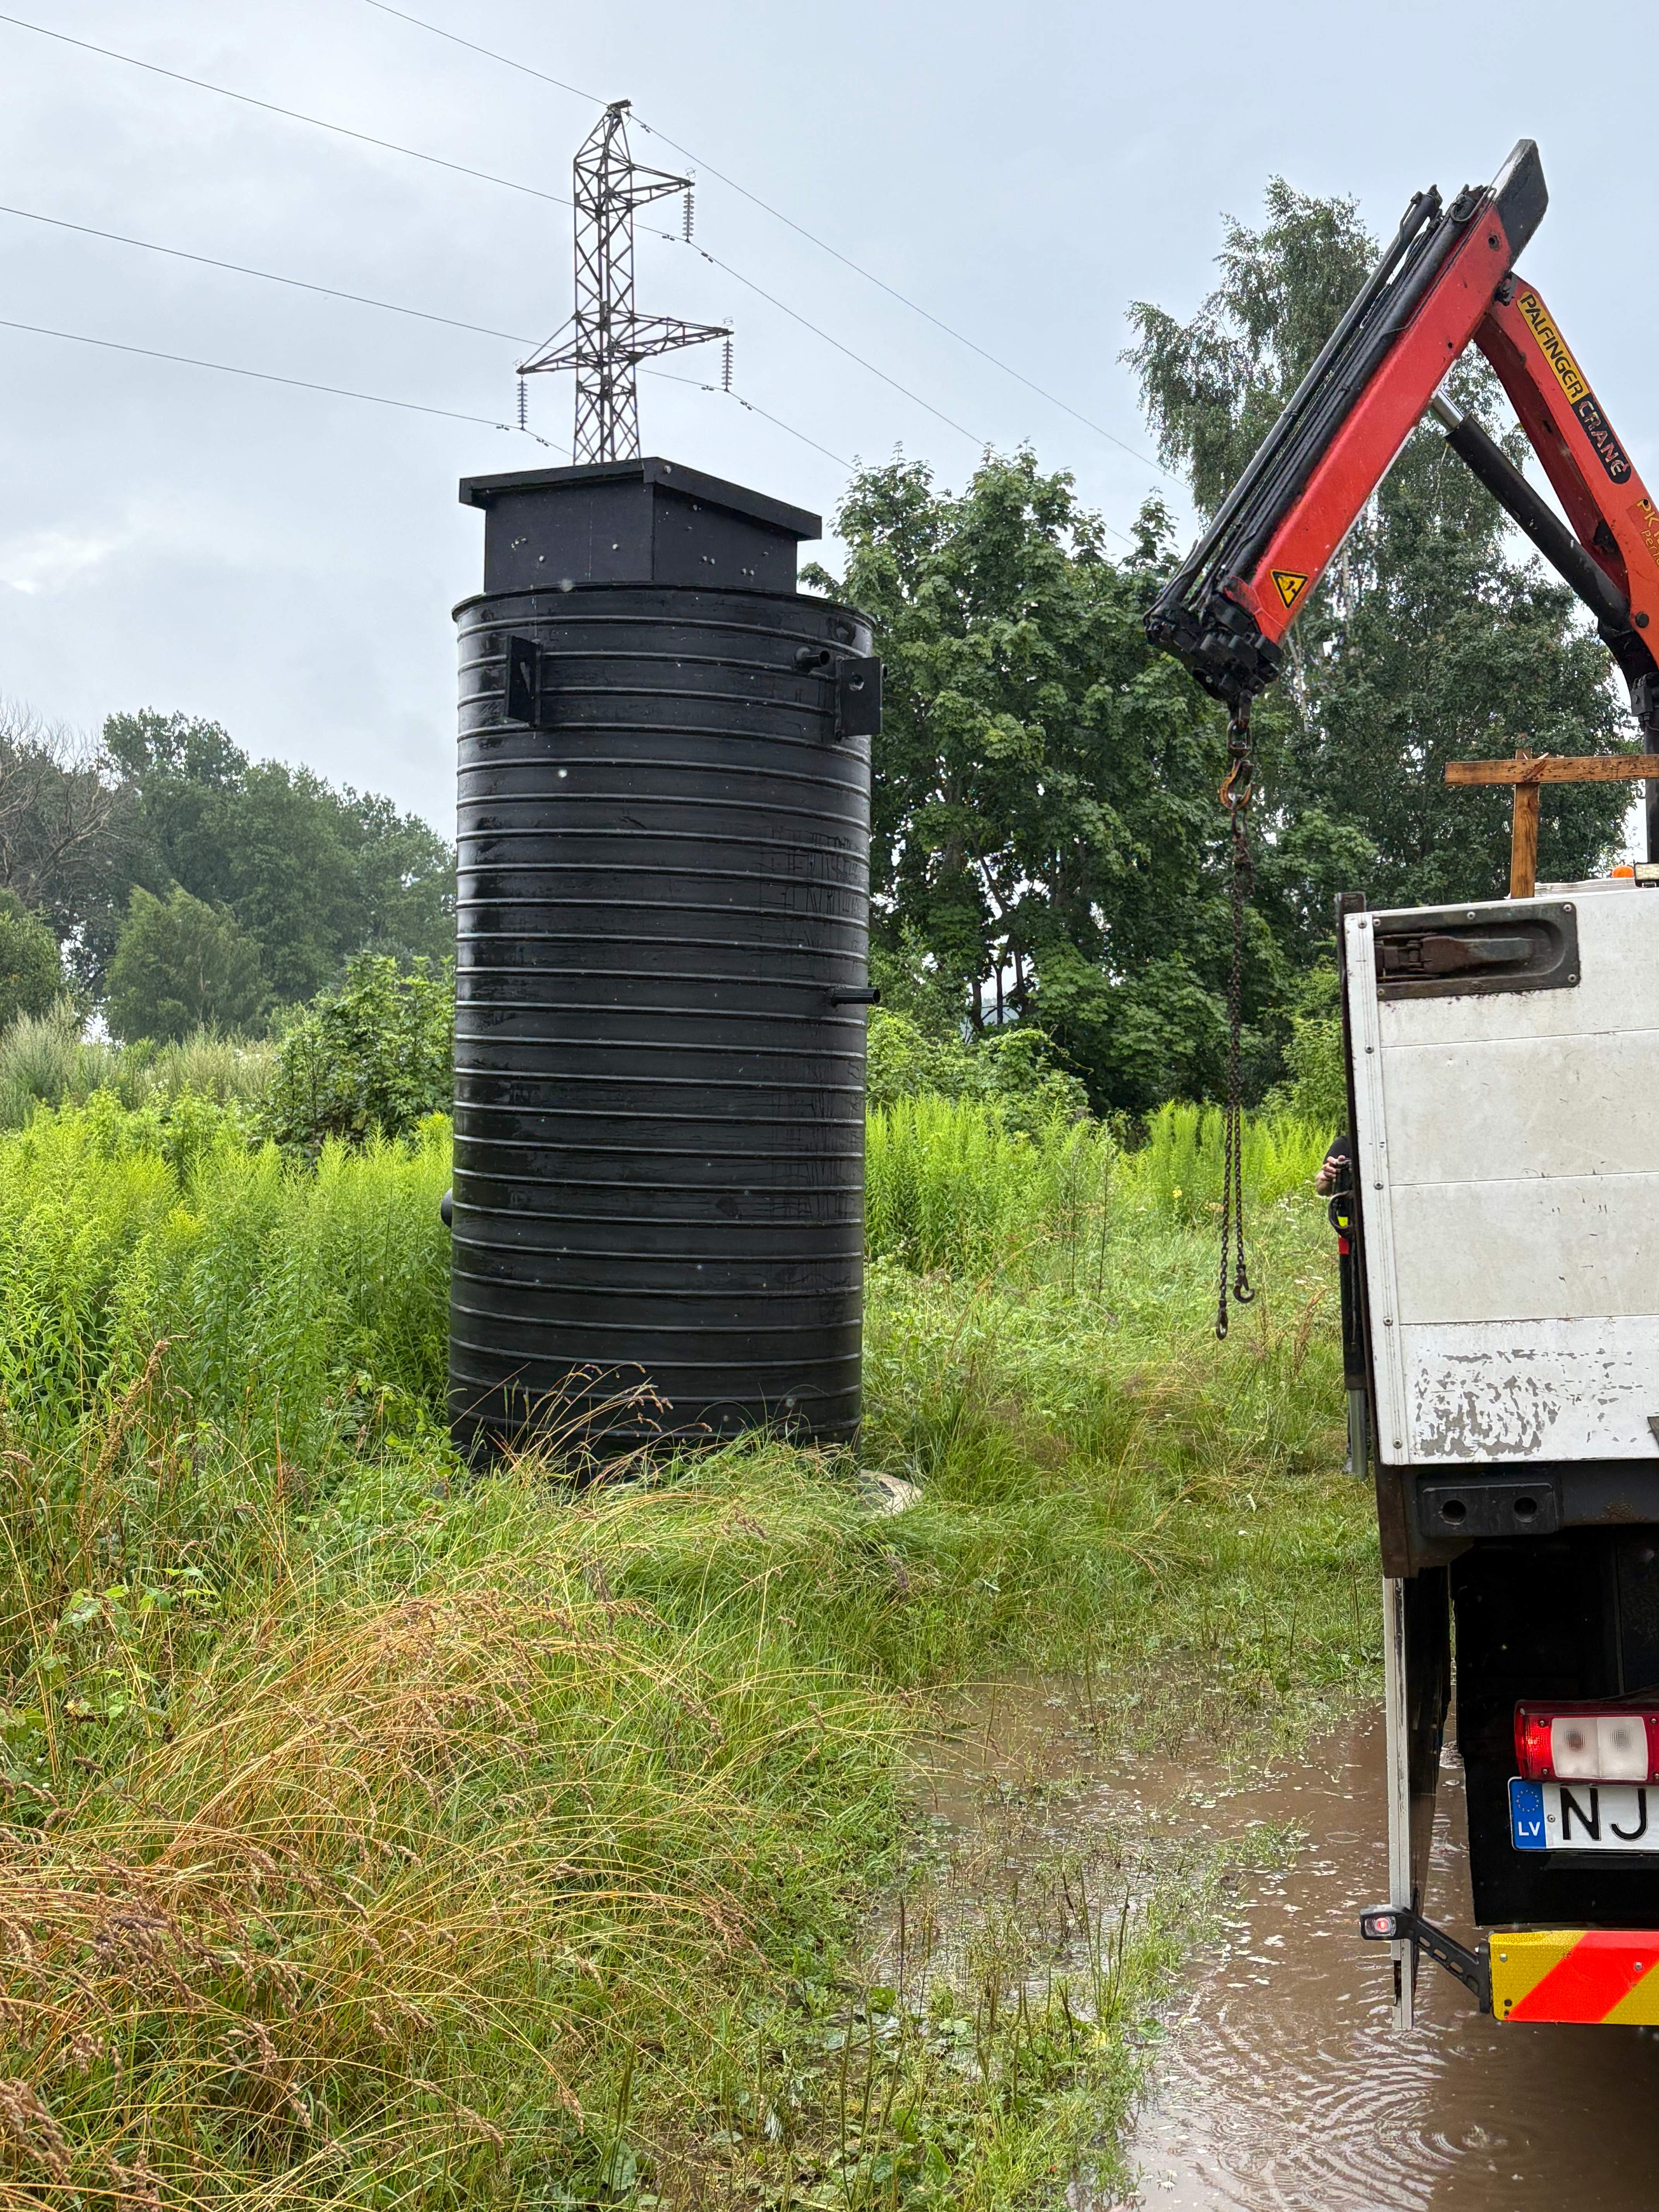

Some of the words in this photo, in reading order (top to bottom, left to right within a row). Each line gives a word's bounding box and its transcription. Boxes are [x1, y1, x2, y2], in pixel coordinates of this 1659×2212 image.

[1520, 294, 1583, 398] PALFINGER
[1578, 400, 1629, 477] CRANE
[1518, 1821, 1540, 1837] LV
[1559, 1787, 1648, 1841] NJ
